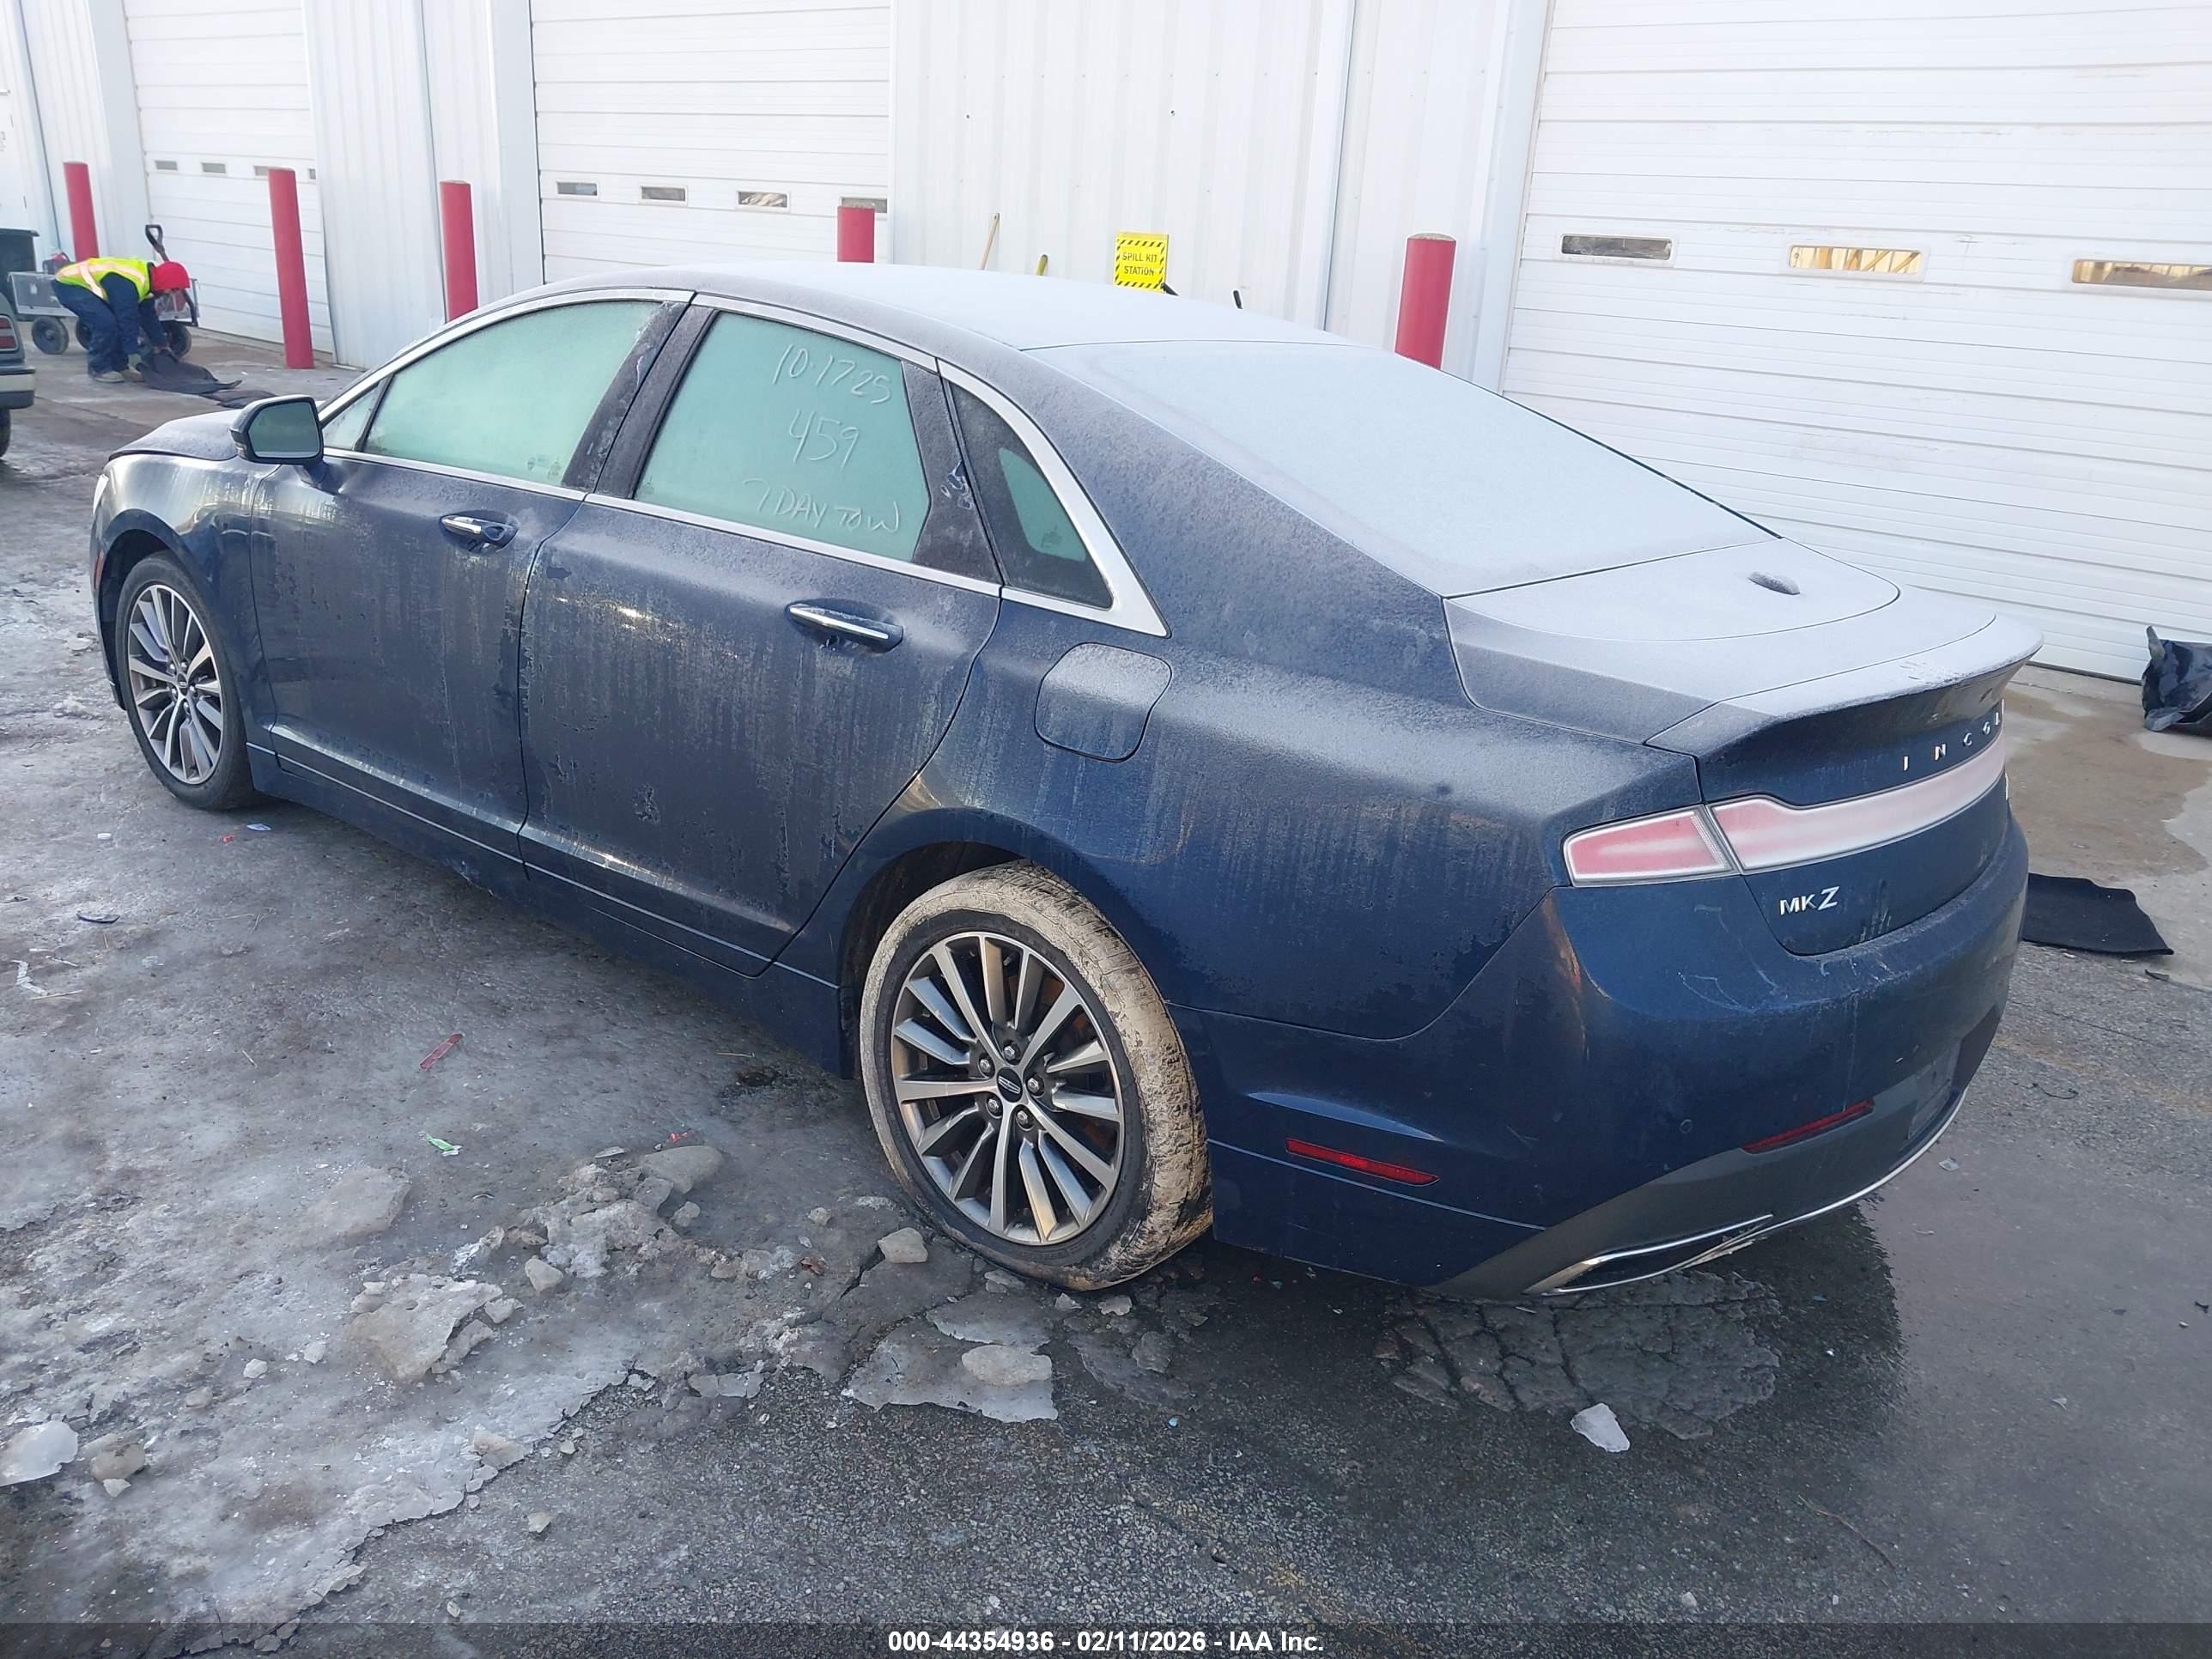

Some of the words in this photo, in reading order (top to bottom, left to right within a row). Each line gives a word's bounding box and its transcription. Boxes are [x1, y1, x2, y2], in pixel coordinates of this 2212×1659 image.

[1121, 252, 1143, 262] SPILL
[1146, 252, 1158, 263] KIT
[1123, 264, 1155, 276] STATION
[788, 408, 860, 471] 459
[775, 486, 828, 528] DAY
[835, 500, 899, 532] TOW
[1779, 885, 1840, 915] MKZ
